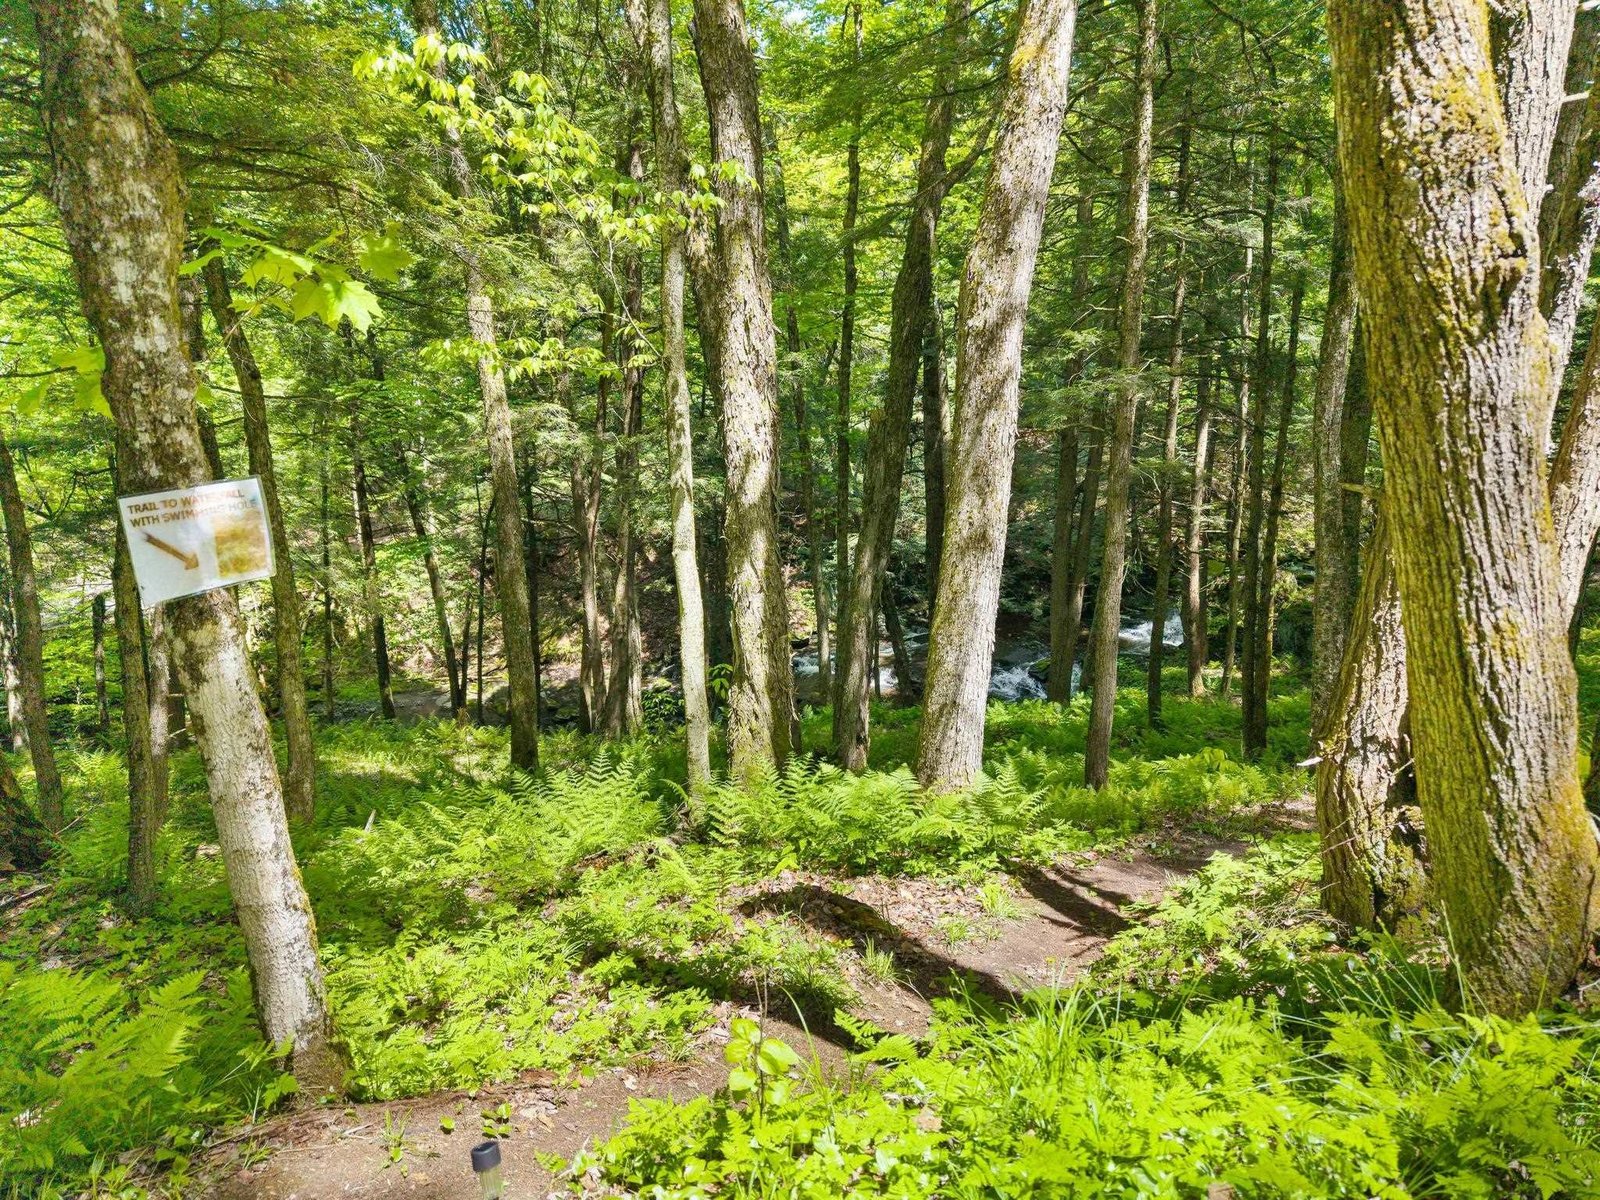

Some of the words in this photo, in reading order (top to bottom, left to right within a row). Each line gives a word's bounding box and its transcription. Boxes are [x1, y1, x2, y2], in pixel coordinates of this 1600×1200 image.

[127, 500, 160, 514] TRAIL
[161, 498, 177, 510] TO
[129, 514, 160, 528] WITH
[228, 498, 257, 512] HOLE
